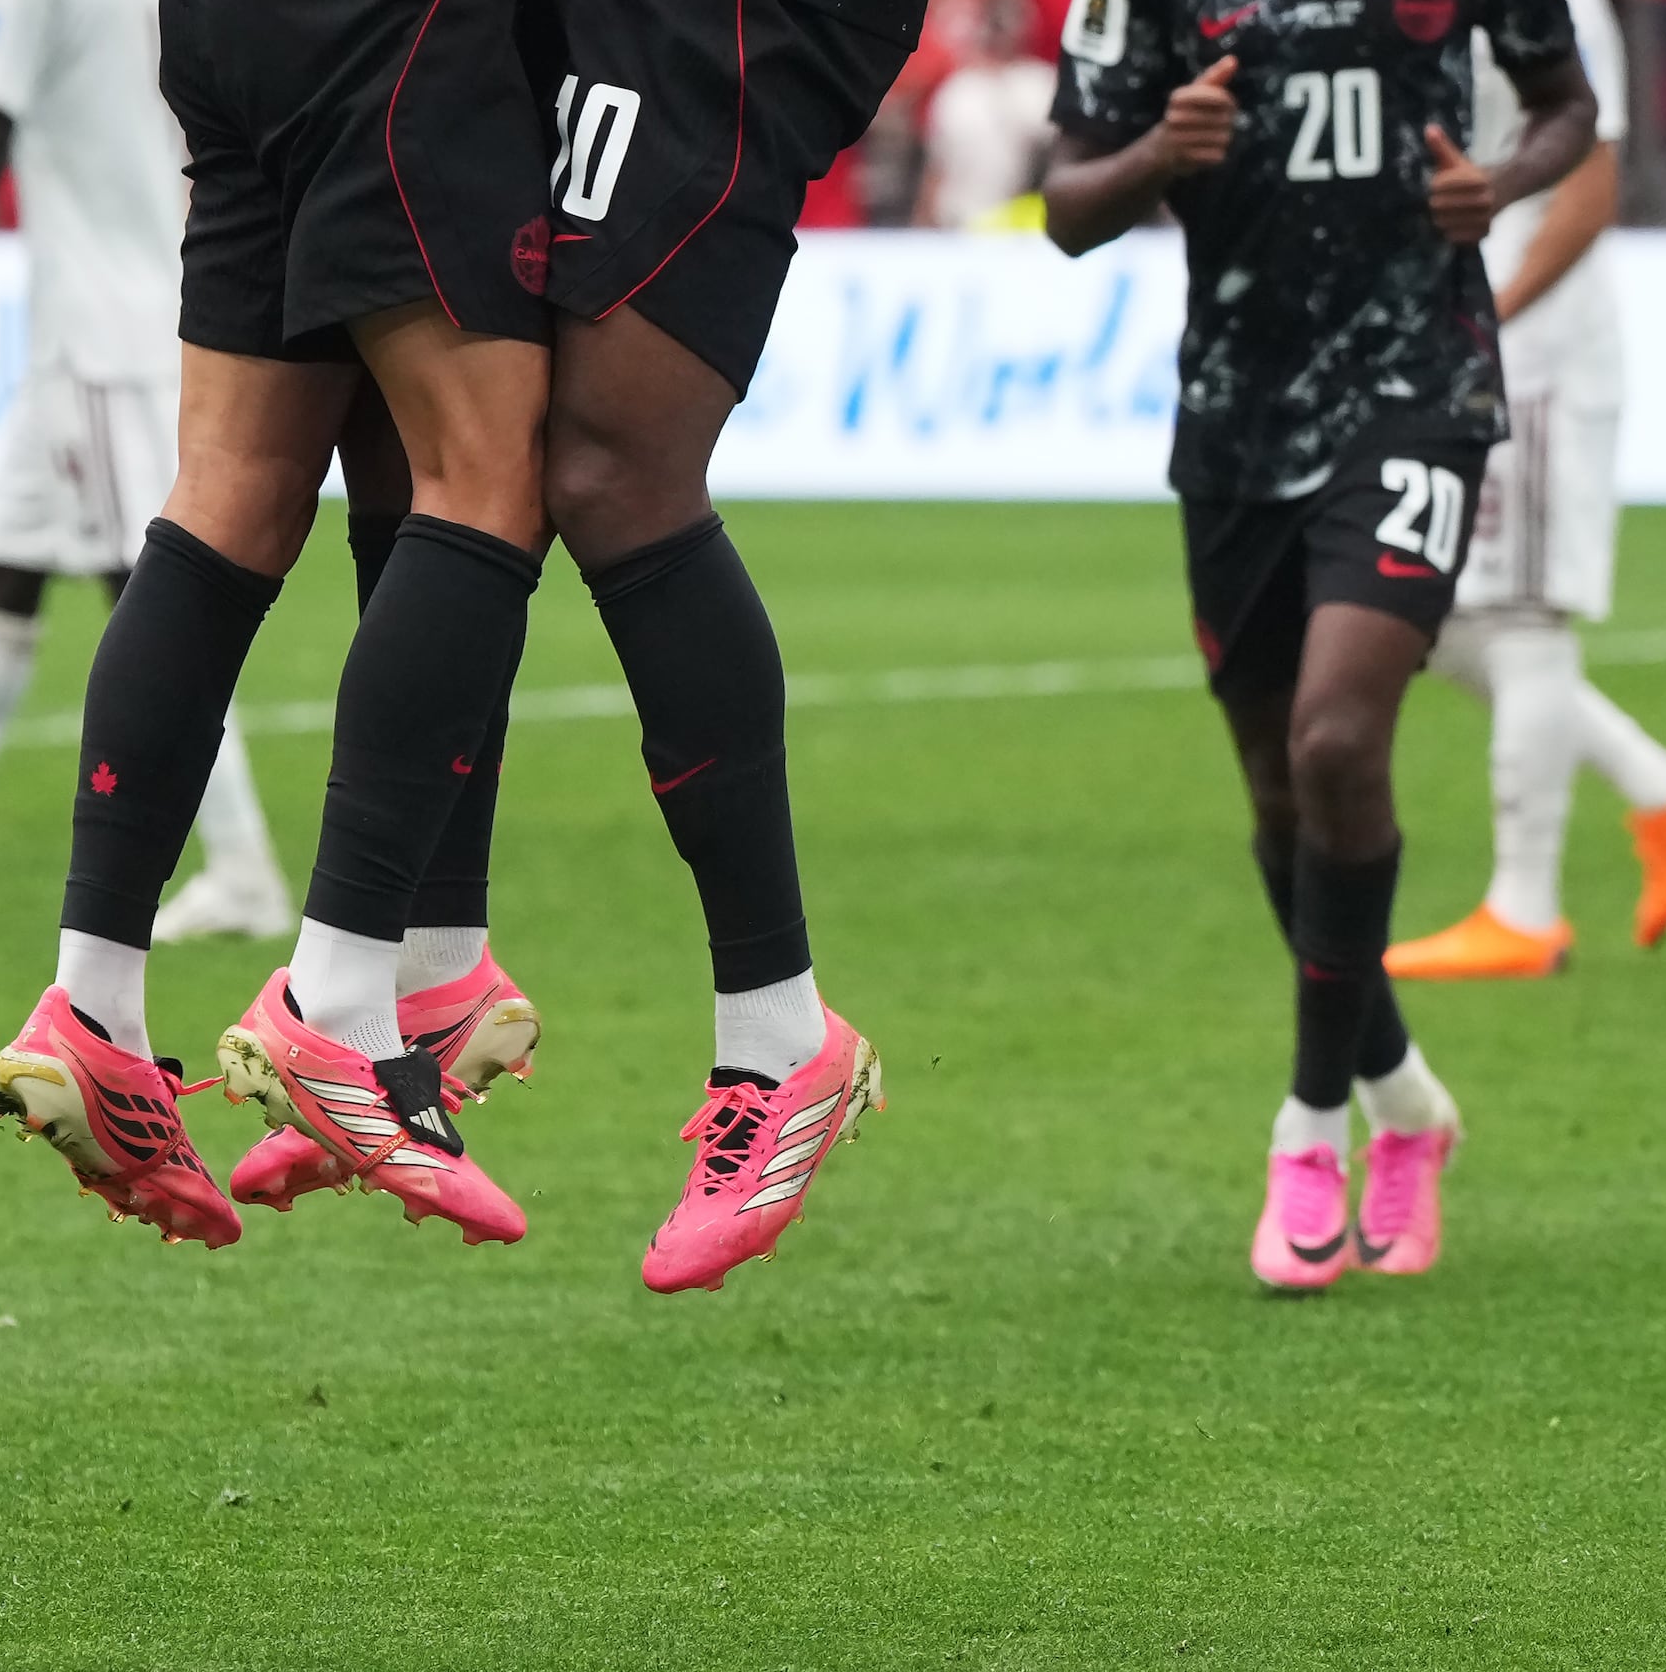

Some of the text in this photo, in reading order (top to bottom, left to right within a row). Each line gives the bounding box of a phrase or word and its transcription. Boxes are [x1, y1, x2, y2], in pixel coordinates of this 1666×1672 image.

[549, 73, 642, 222] 10
[1284, 67, 1383, 182] 20
[1375, 458, 1465, 575] 20
